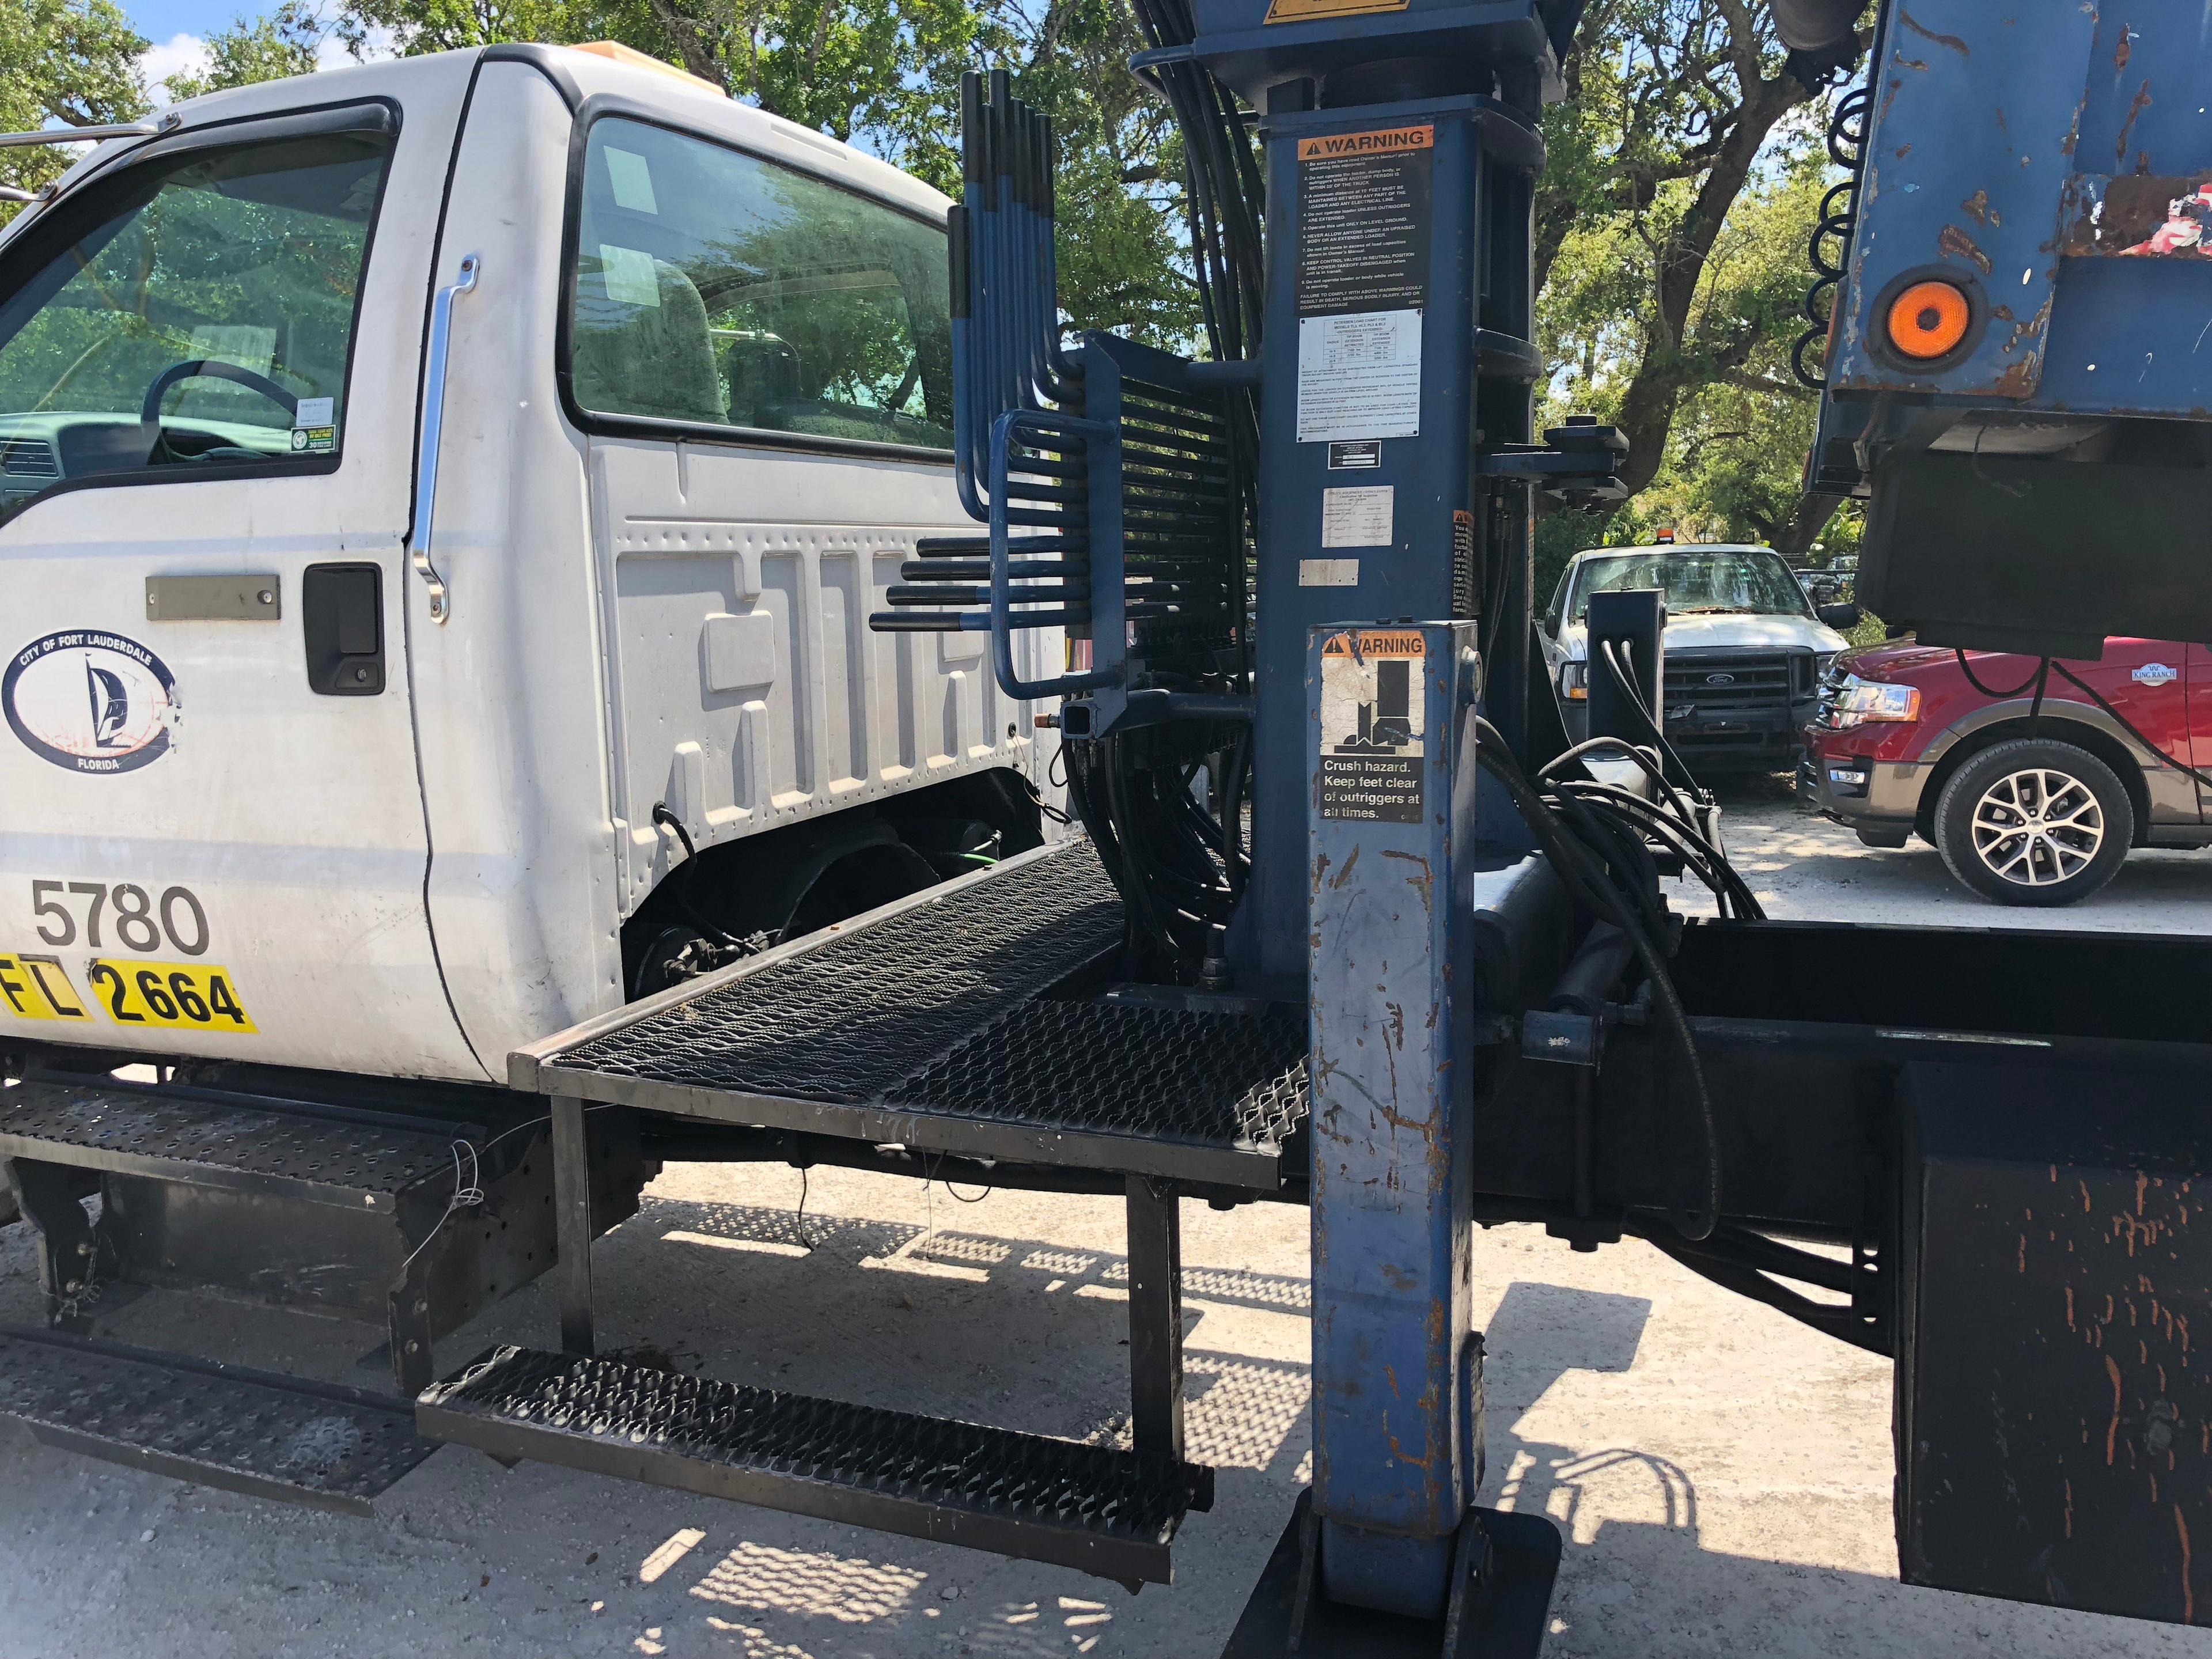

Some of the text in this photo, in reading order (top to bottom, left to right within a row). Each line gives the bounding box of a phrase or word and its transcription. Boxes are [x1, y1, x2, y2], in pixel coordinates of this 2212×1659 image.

[1325, 131, 1424, 153] WARNING
[20, 634, 153, 666] CITY OF FORT LAUDERDALE
[2134, 669, 2175, 678] KING RANCH
[78, 758, 120, 770] FLORIDA
[1324, 760, 1411, 772] Crush hazard.
[1324, 775, 1418, 789] Keep feet clear
[1339, 792, 1405, 805] outriggers
[1407, 793, 1420, 804] at
[1341, 806, 1380, 819] times.
[33, 880, 210, 956] 5780
[92, 964, 246, 1024] 2664
